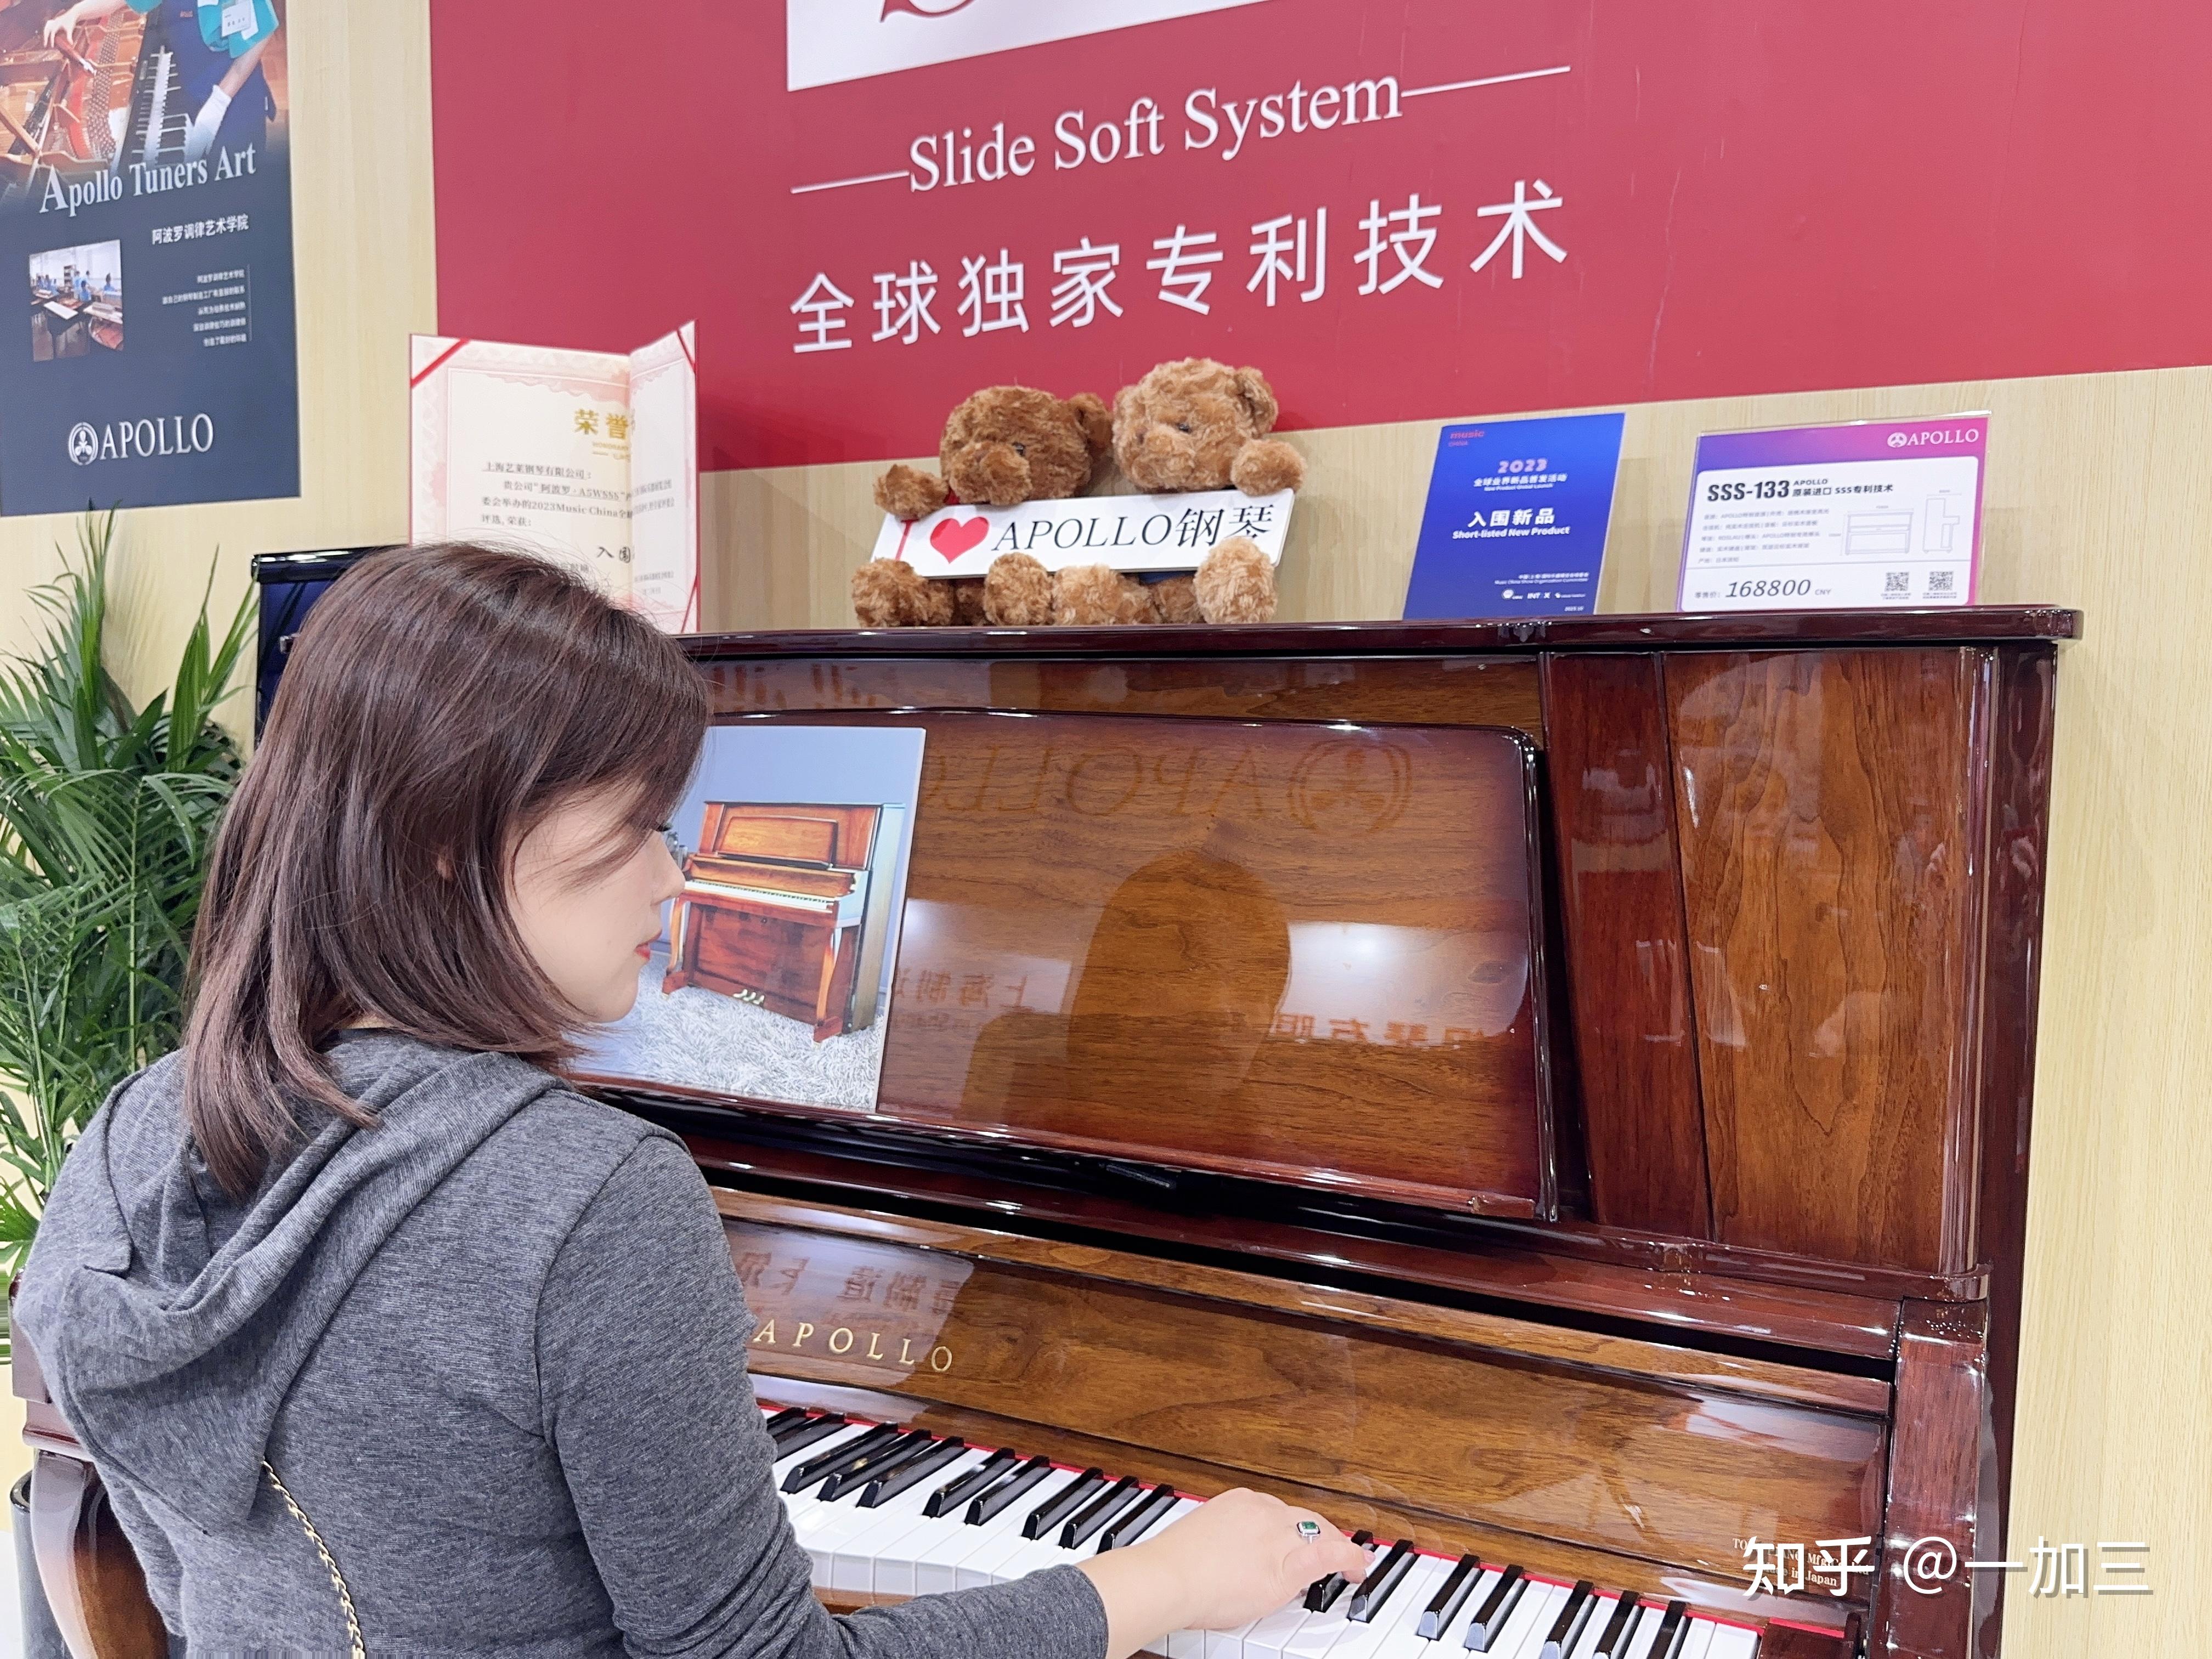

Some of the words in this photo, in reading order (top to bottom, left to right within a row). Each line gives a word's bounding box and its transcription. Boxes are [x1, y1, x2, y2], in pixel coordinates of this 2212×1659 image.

[909, 122, 1035, 193] Slide
[1054, 97, 1164, 170] Soft
[1184, 75, 1403, 160] System
[40, 163, 123, 217] Apollo
[130, 158, 208, 196] Tuners
[215, 142, 256, 182] Art
[151, 213, 250, 245] 阿波罗调律艺术学院
[790, 179, 1568, 353] 全球独家专利技术
[99, 413, 214, 461] APOLLO
[1908, 428, 1979, 447] APOLLO
[1497, 458, 1548, 474] 2023
[1707, 480, 1790, 501] SSS-133
[992, 504, 1274, 551] APOLLO钢琴
[1468, 507, 1555, 528] 入围新品
[1453, 529, 1508, 539] Short-listed
[1508, 528, 1530, 537] New
[1531, 526, 1571, 535] Product
[1725, 579, 1811, 598] 168800
[752, 1319, 953, 1372] APOLLO
[1805, 1570, 1837, 1587] Japan
